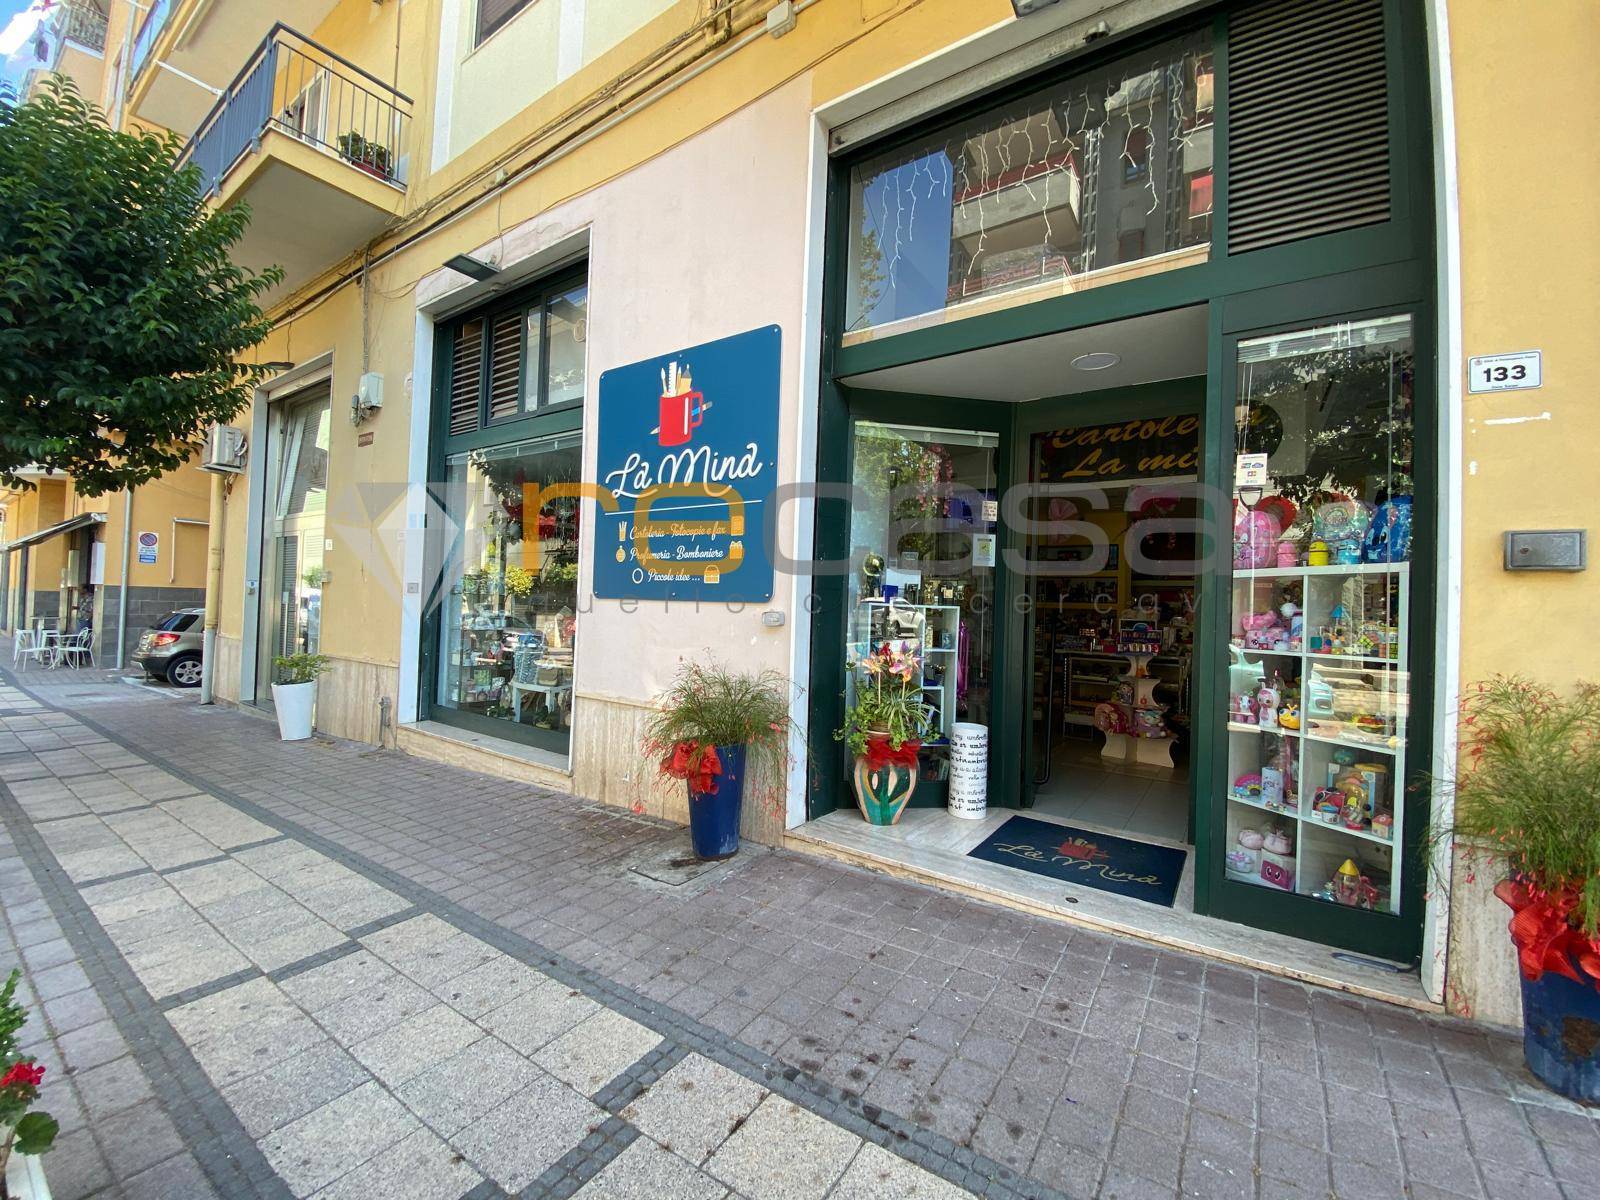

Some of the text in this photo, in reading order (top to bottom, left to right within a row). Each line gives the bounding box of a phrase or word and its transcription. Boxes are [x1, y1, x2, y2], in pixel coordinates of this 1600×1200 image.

[1483, 364, 1527, 382] 133
[605, 442, 763, 499] La Mina
[1062, 447, 1126, 479] La
[630, 544, 724, 566] Profumeria Bomboniere
[647, 567, 675, 583] Piccole
[993, 842, 1162, 886] La Mina
